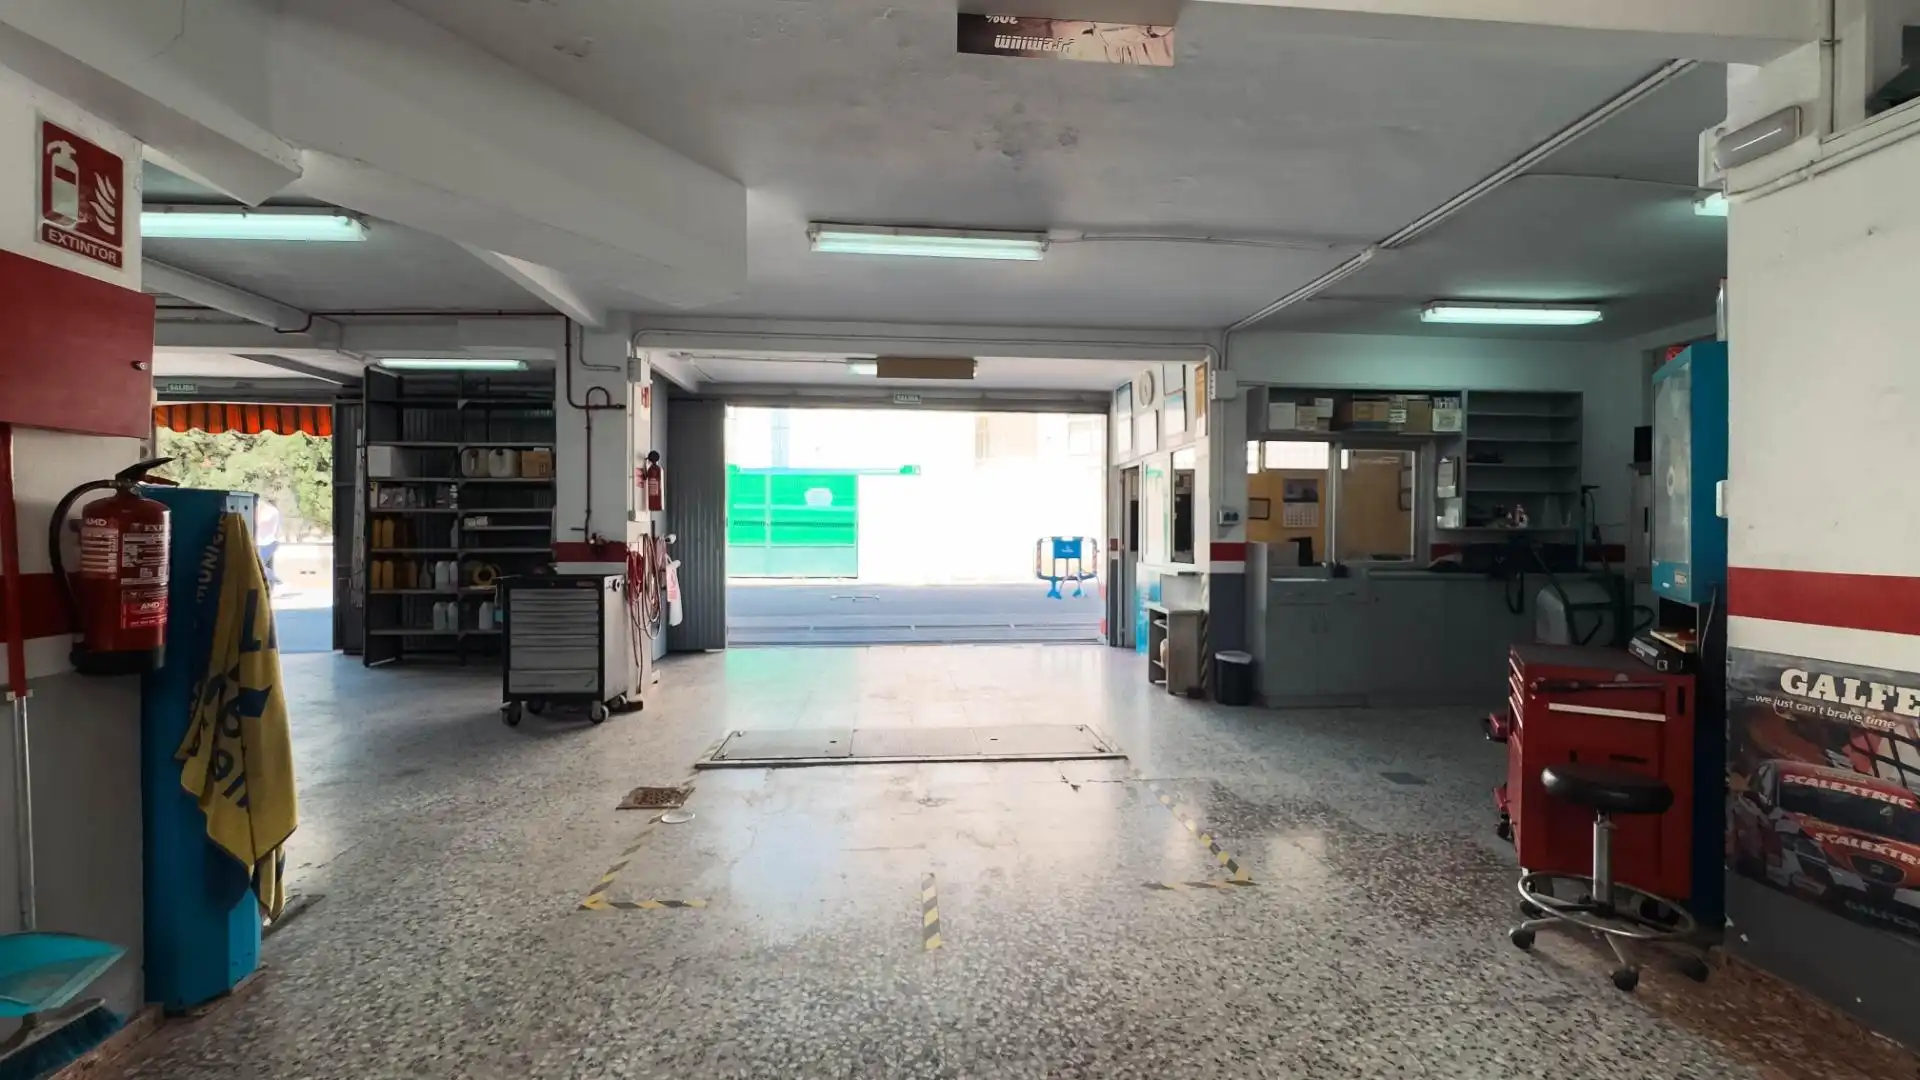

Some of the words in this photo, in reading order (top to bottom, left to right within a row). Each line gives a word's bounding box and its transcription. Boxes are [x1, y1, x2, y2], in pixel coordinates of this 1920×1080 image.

[48, 229, 117, 265] EXTINTOR
[1773, 696, 1793, 709] just
[1796, 703, 1824, 715] can't
[1827, 706, 1863, 723] brake
[1783, 774, 1914, 809] SCALEXTRIC
